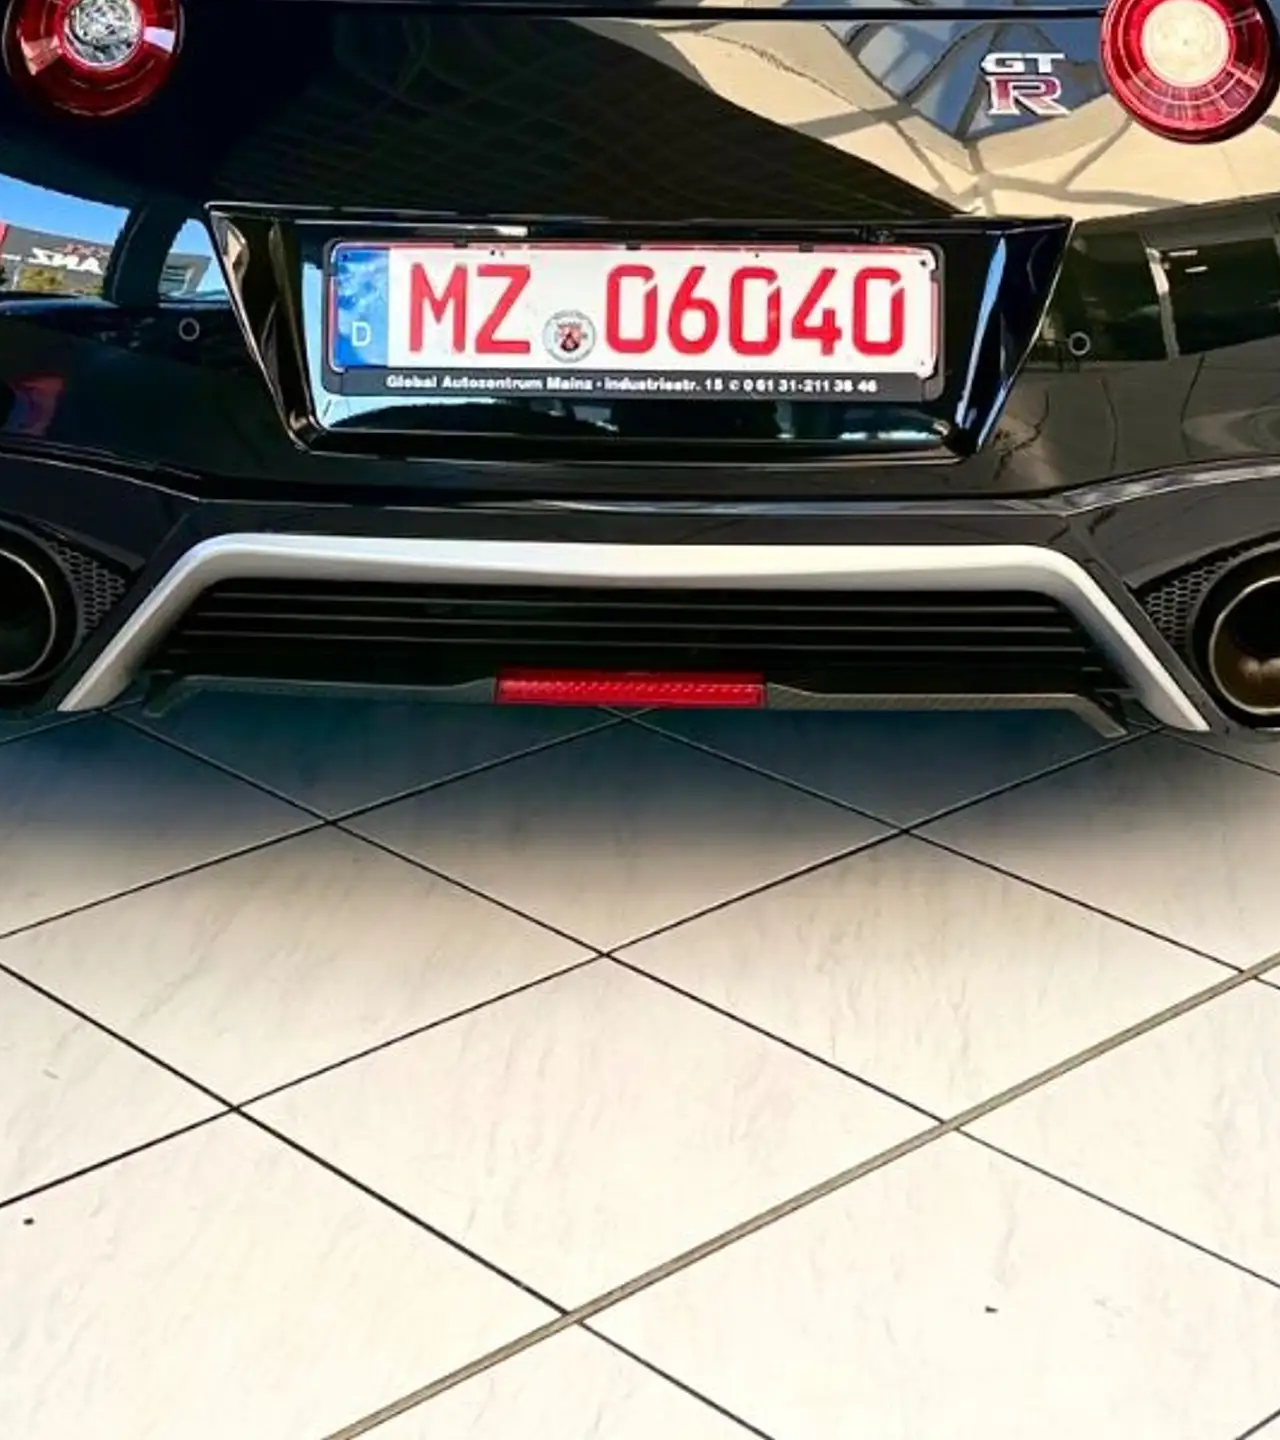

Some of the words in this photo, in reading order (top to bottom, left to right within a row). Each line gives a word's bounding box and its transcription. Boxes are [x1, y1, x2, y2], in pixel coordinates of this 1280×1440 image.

[981, 53, 1065, 73] GT
[986, 75, 1070, 115] R
[410, 263, 531, 353] MZ
[606, 264, 905, 356] 06040
[352, 322, 371, 347] D
[386, 375, 437, 389] Global
[442, 375, 543, 390] Autozentrum
[546, 376, 594, 391] Mainz
